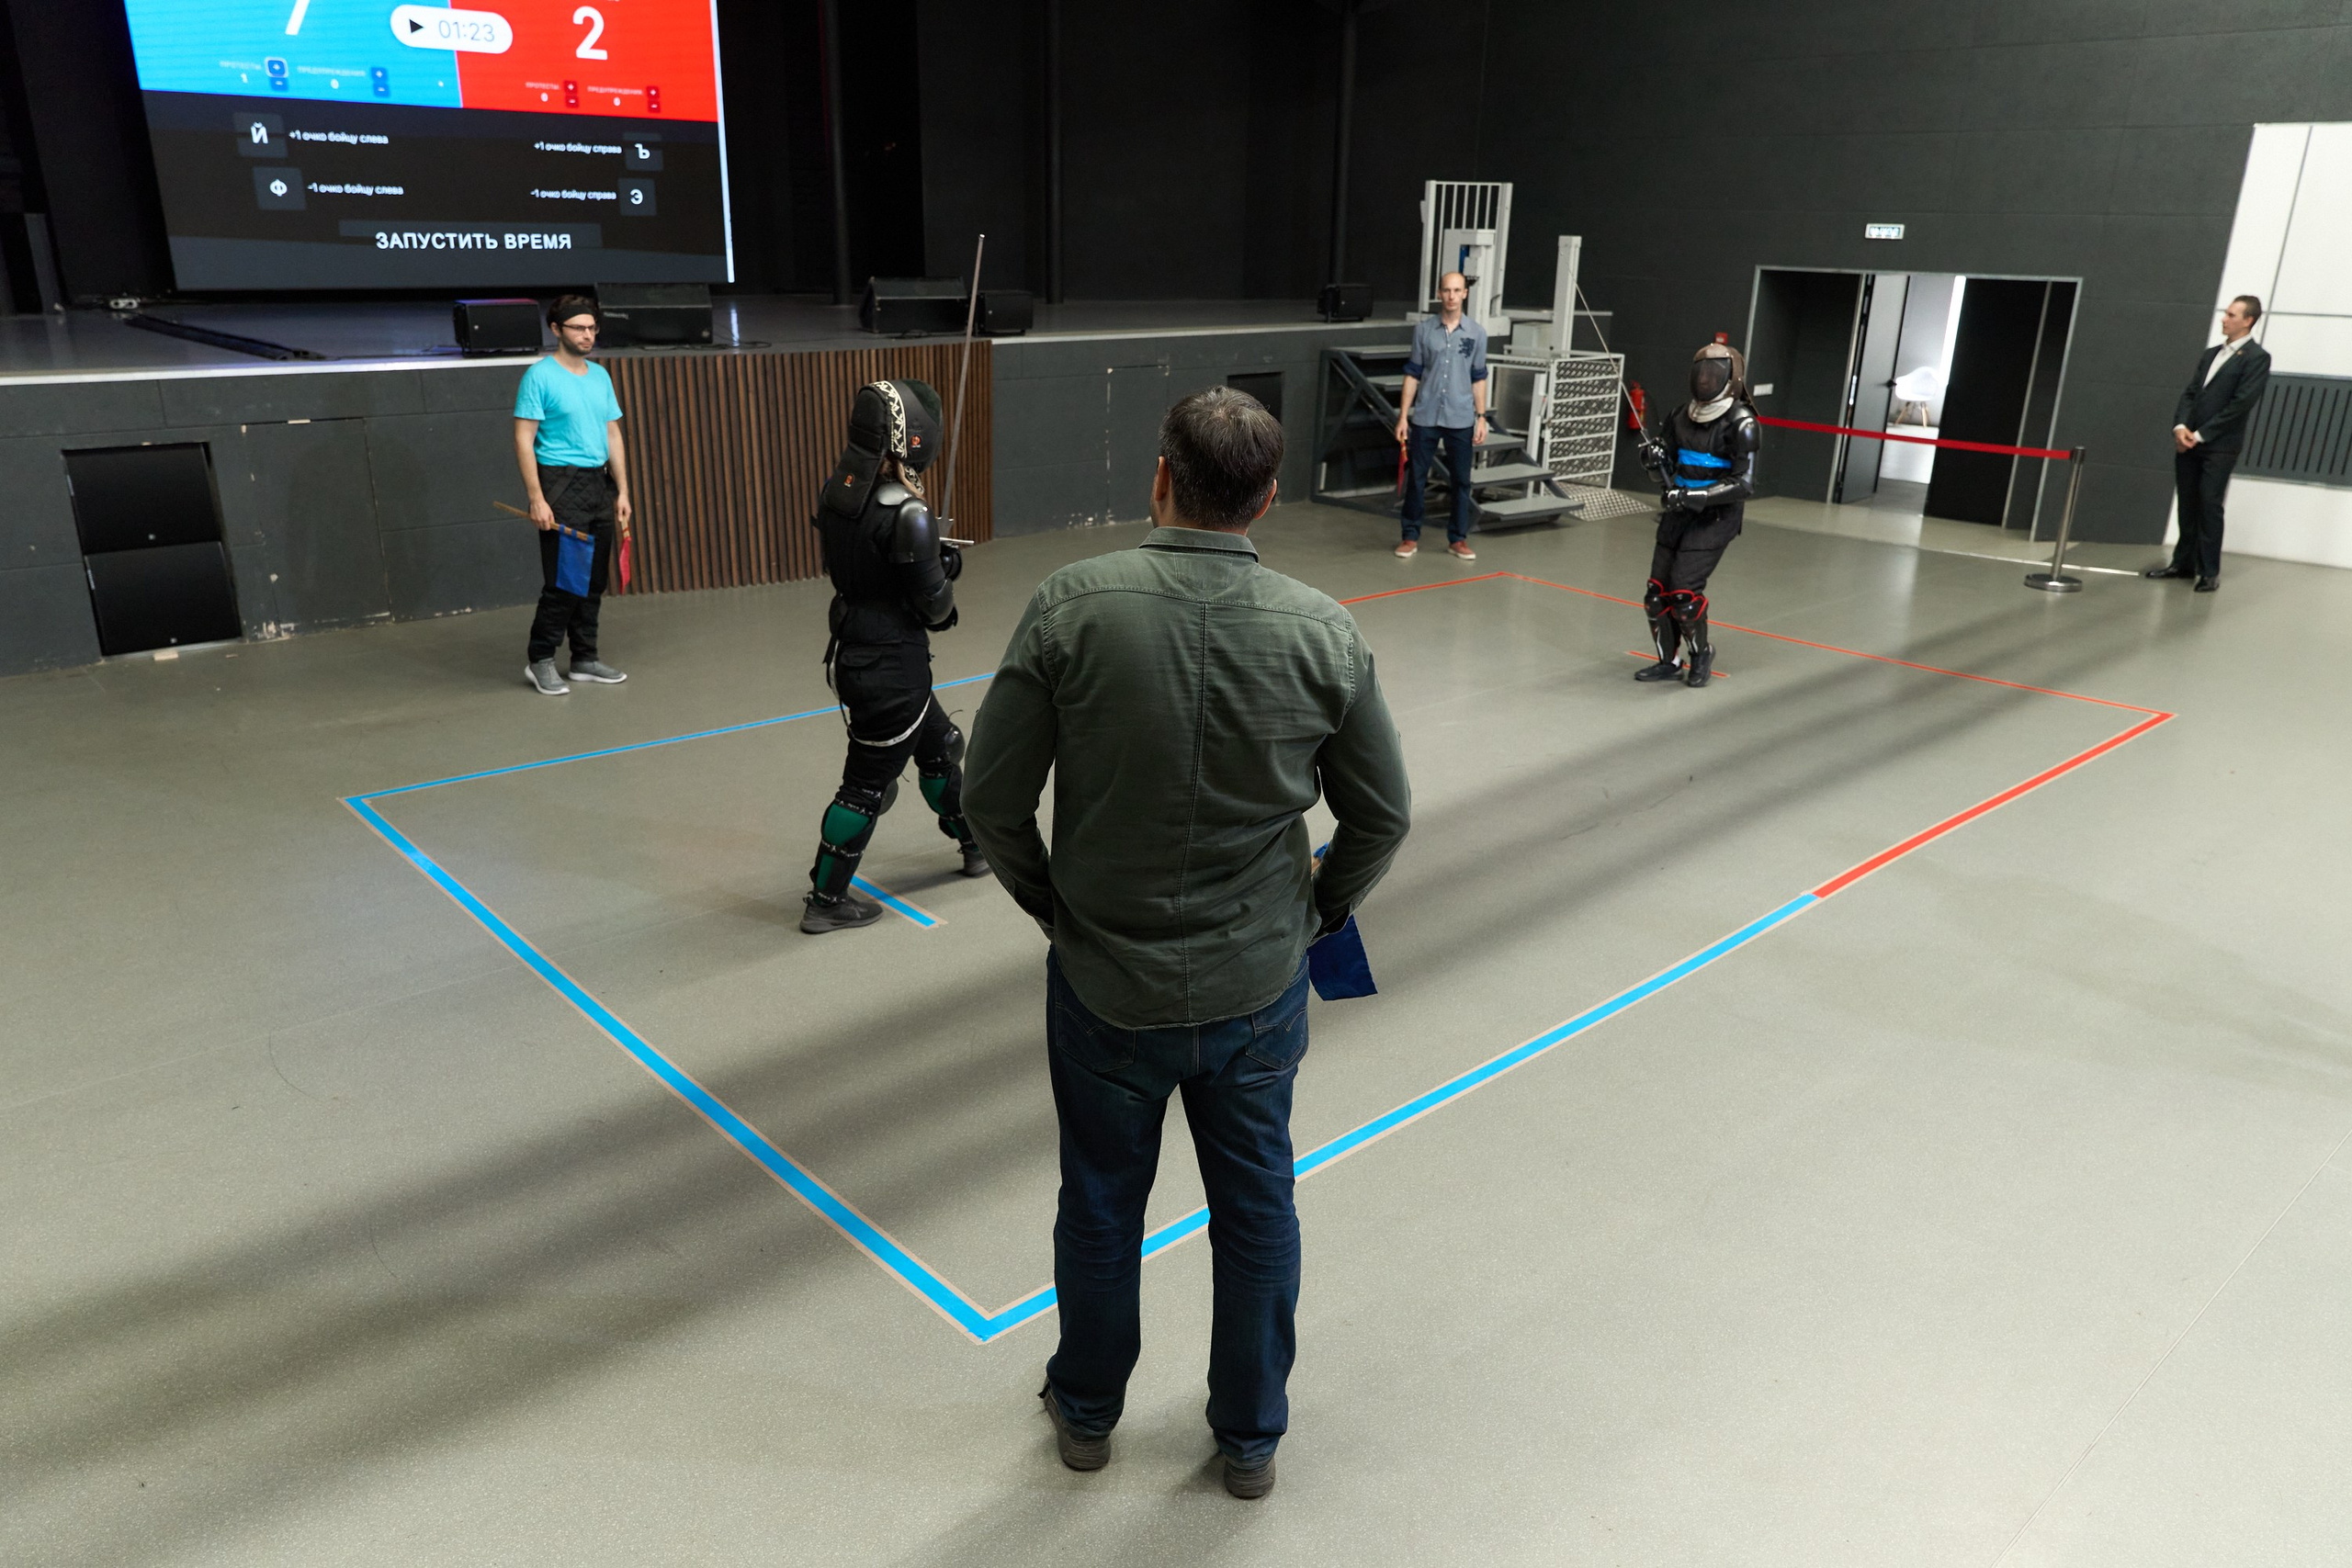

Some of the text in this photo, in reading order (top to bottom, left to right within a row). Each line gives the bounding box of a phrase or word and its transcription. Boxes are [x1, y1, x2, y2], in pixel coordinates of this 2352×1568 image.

[438, 19, 496, 42] 01:23
[572, 6, 608, 61] 2
[250, 121, 269, 144] Й
[288, 130, 390, 145] +1 очко бойцу слева
[534, 141, 623, 155] +1 очко бойцу справа
[269, 178, 288, 197] Ф
[319, 185, 344, 195] очко
[344, 184, 374, 197] бойцу
[375, 186, 404, 196] слева
[540, 190, 560, 199] очко
[560, 188, 587, 201] бойцу
[587, 191, 617, 201] справа
[629, 188, 643, 205] Э
[375, 231, 572, 250] ЗАПУСТИТЬ ВРЕМЯ
